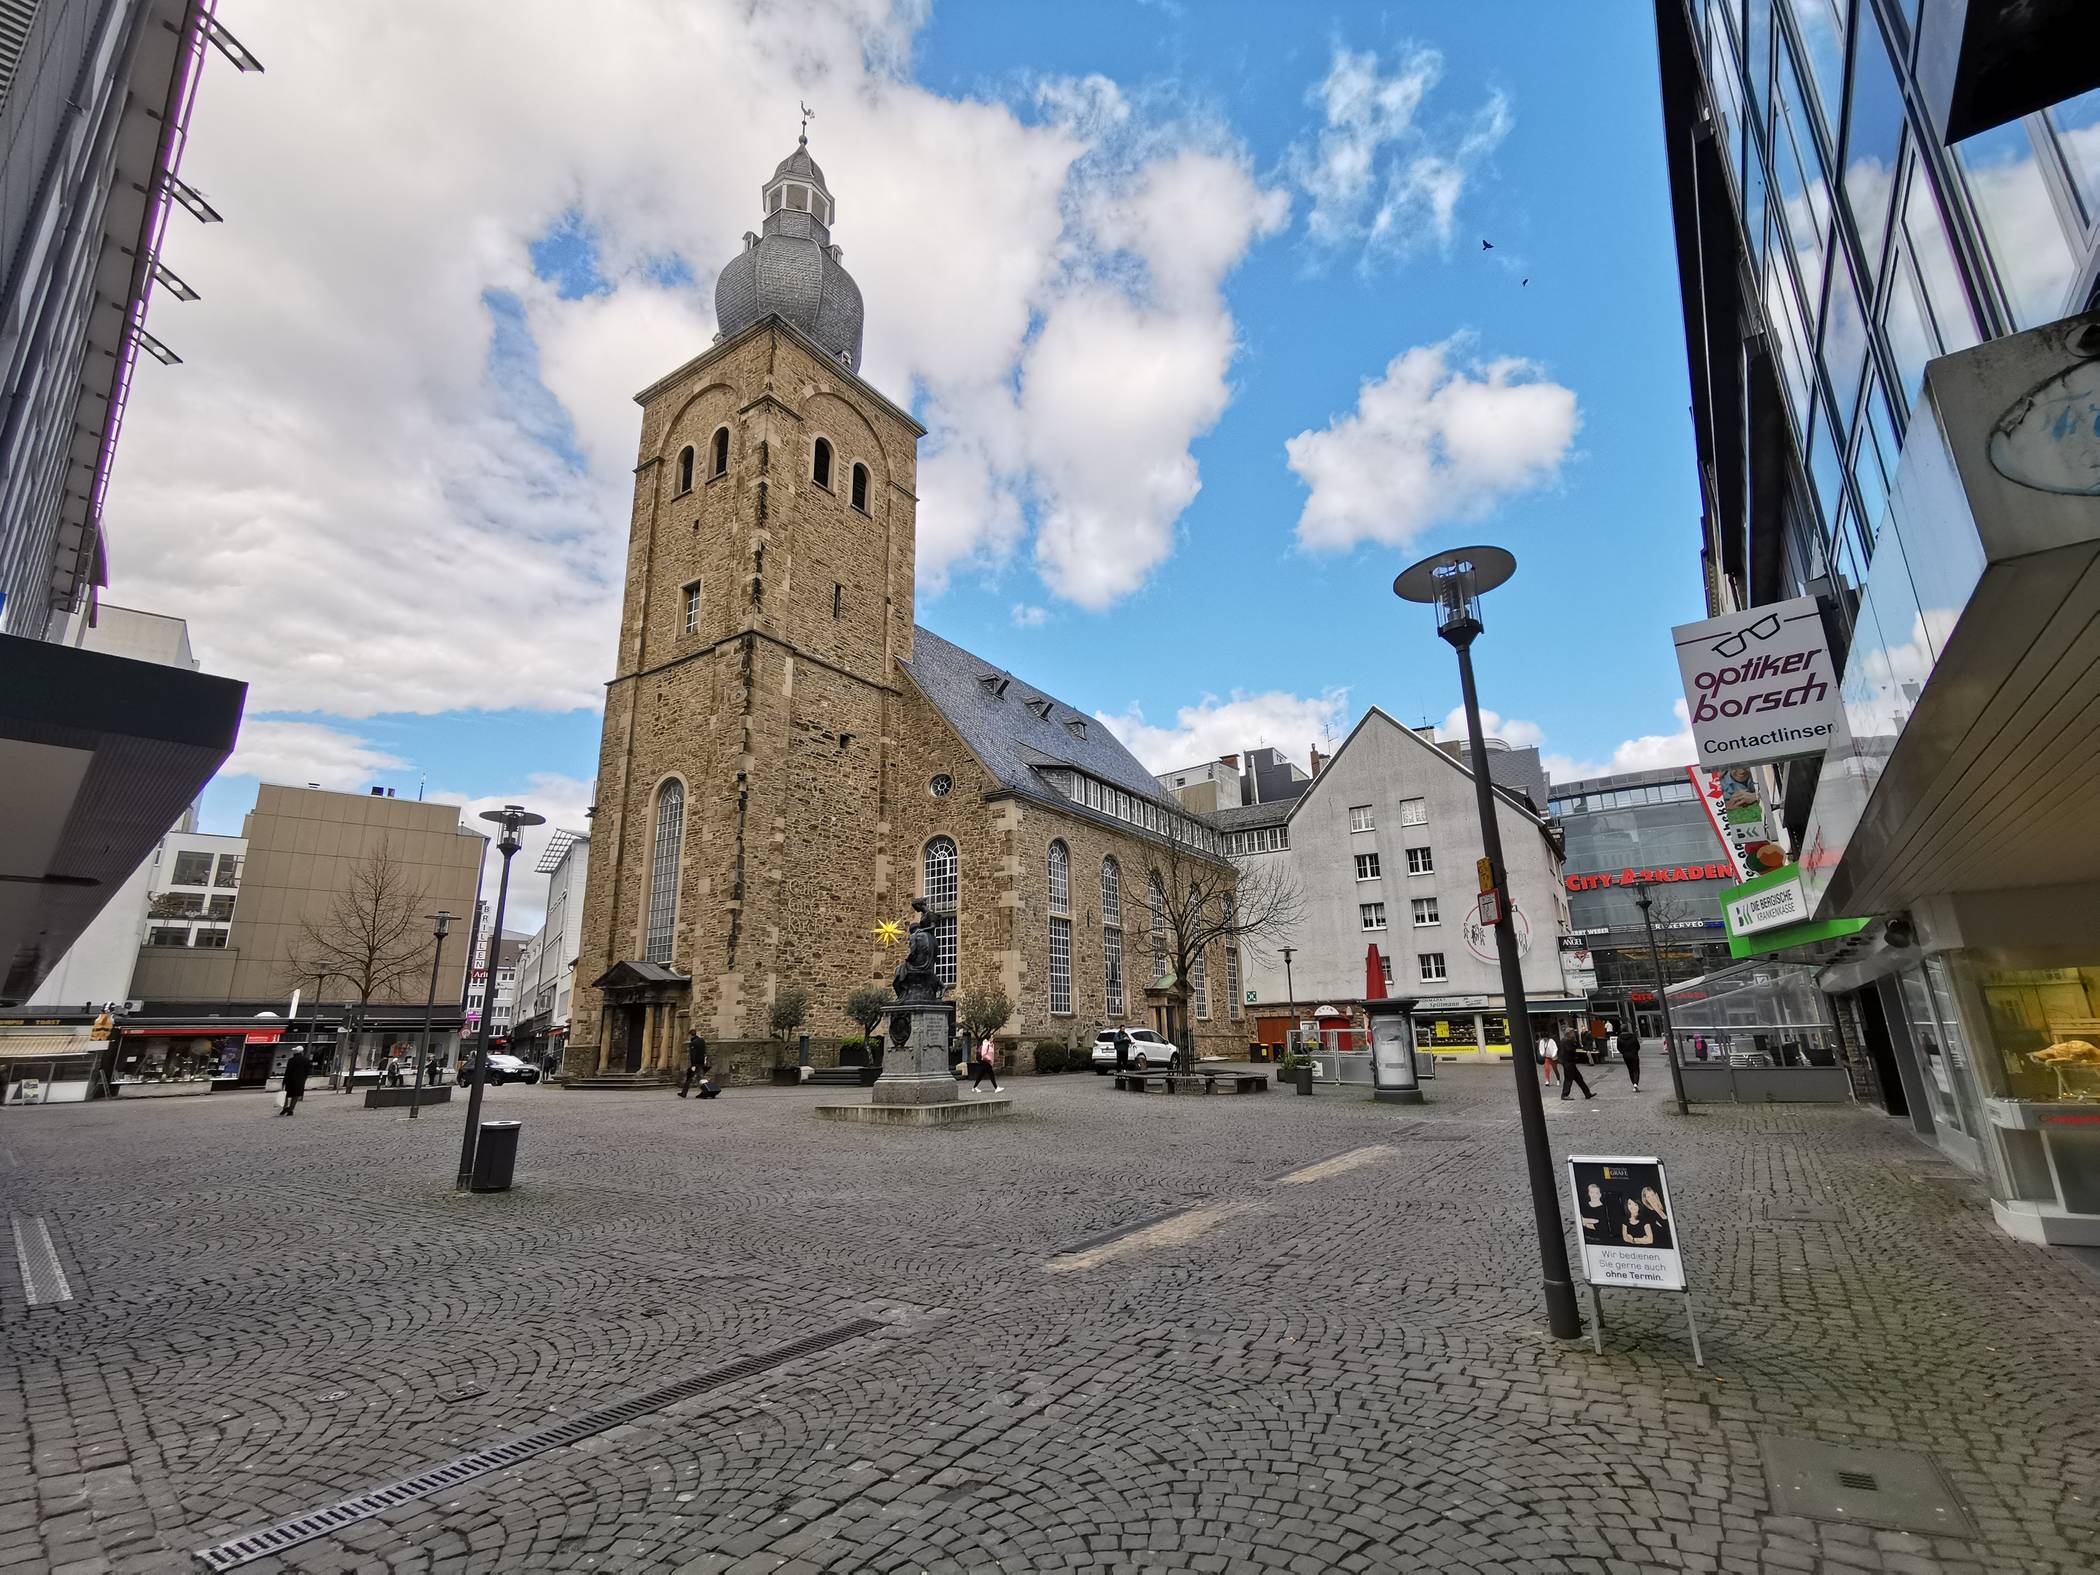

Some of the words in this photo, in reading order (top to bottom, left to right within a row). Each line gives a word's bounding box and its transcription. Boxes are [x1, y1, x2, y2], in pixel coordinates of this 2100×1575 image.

[1694, 648, 1822, 699] optiker
[1692, 672, 1828, 723] borsch
[1750, 901, 1760, 912] DIE
[1760, 889, 1793, 909] BERGISCHE
[1757, 903, 1795, 921] KRANKENKASSE
[477, 905, 490, 968] BRILLEN
[1600, 1260, 1613, 1268] Sie
[1616, 1262, 1641, 1270] gerne
[1602, 1250, 1616, 1258] Wir
[1620, 1252, 1661, 1261] bedienen
[1606, 1270, 1627, 1278] ohne
